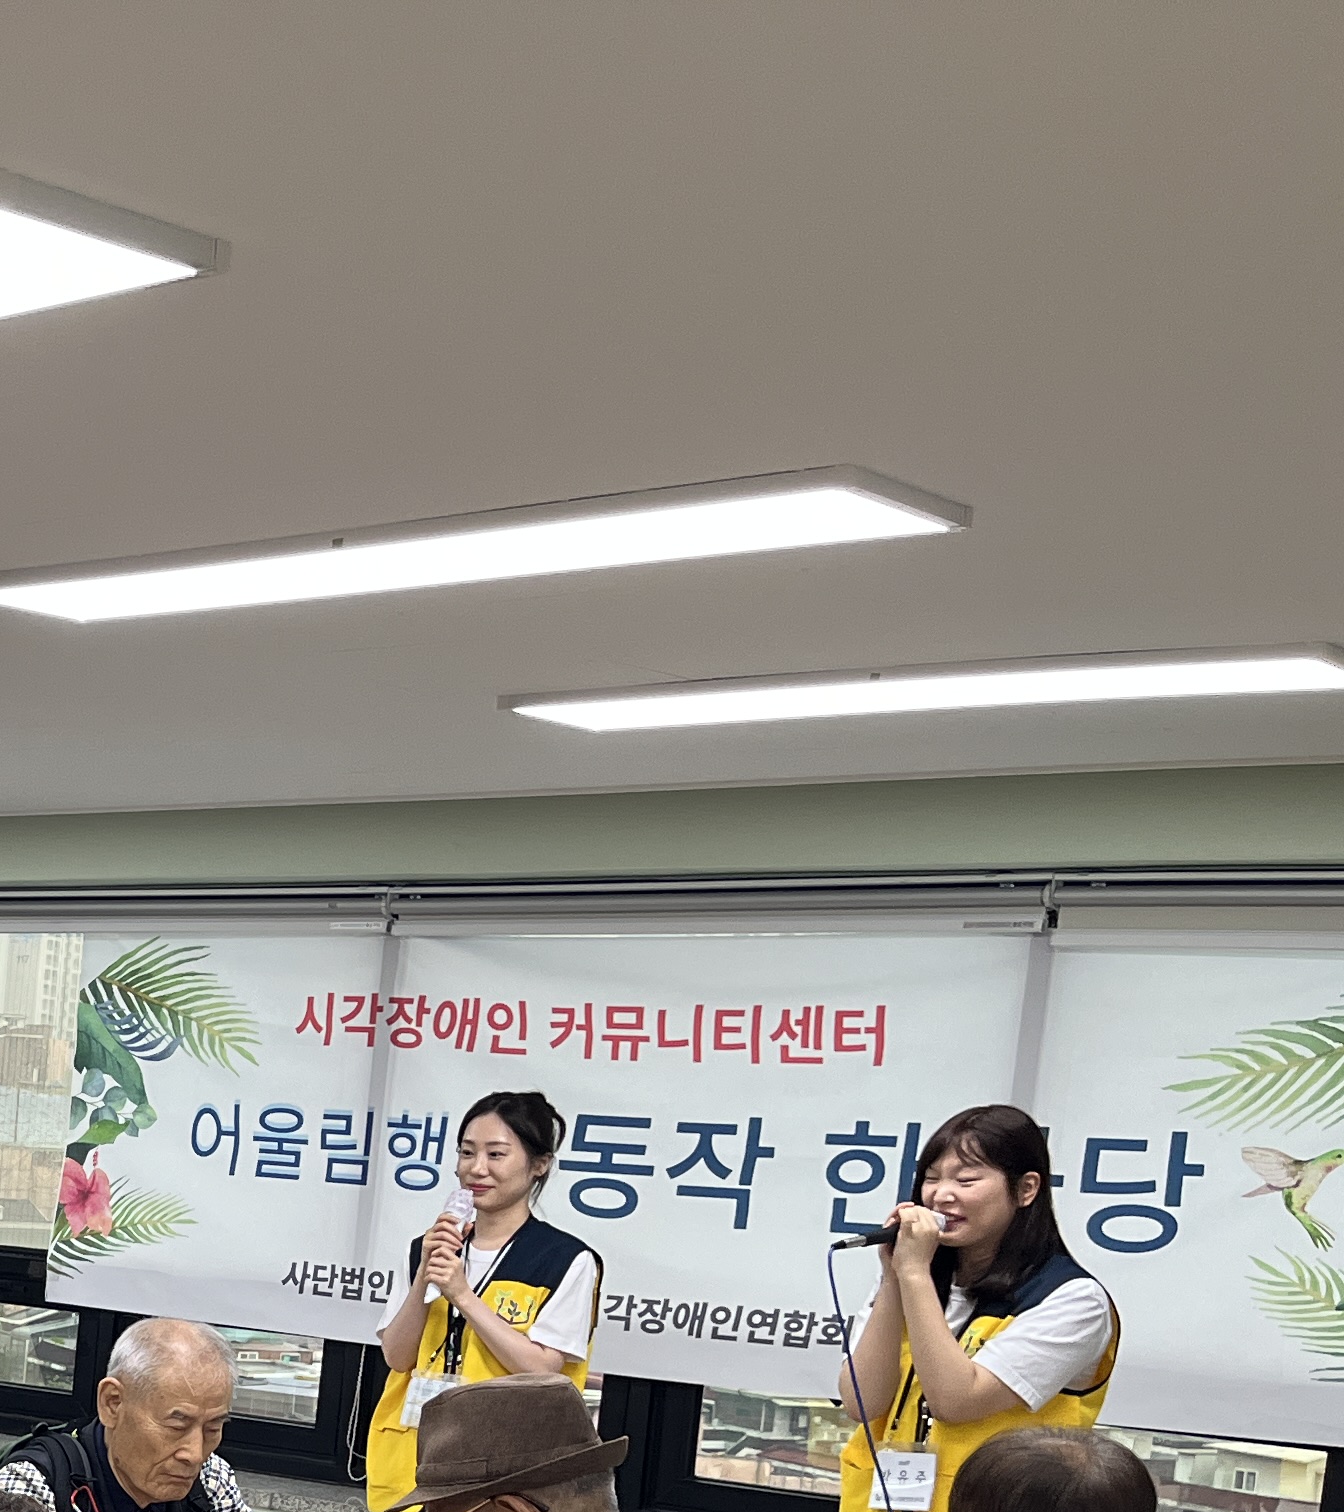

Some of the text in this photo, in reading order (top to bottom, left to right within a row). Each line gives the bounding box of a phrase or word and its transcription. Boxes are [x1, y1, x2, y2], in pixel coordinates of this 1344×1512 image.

[295, 992, 886, 1067] 시각장애인 커뮤니티센터
[191, 1099, 1204, 1253] 어울림행 동작 한당
[281, 1261, 855, 1352] 사단법인 각장애인연합회
